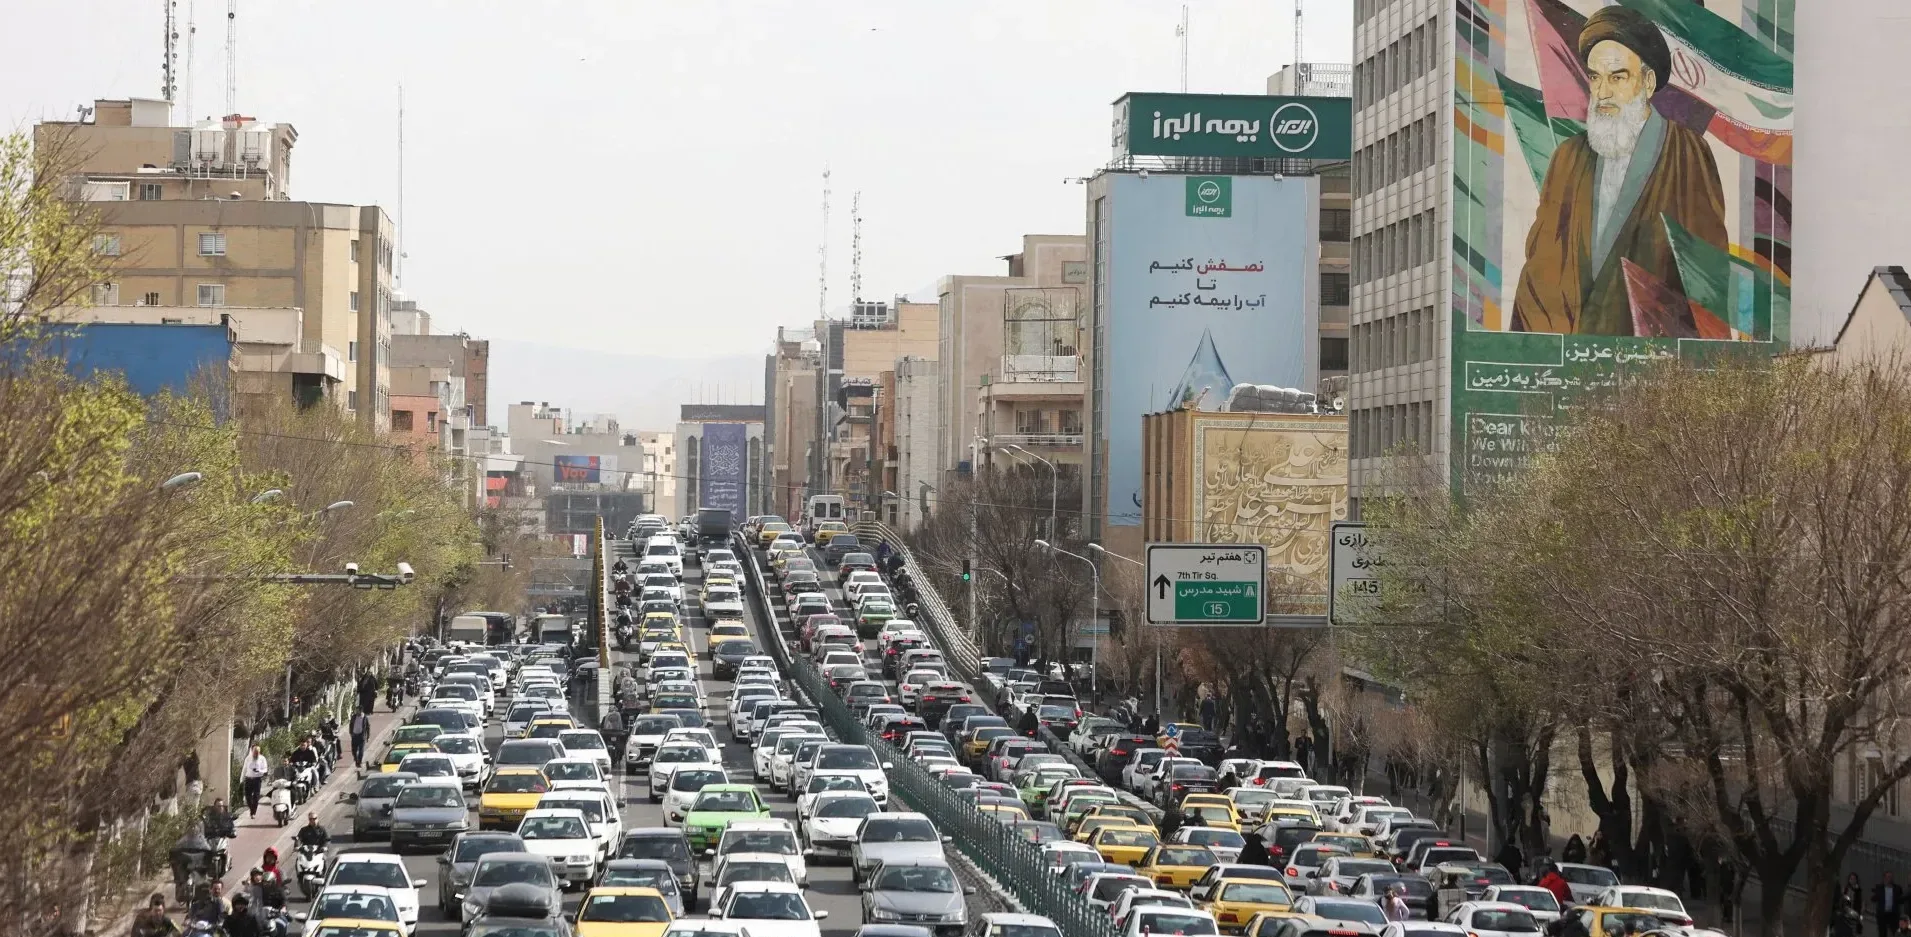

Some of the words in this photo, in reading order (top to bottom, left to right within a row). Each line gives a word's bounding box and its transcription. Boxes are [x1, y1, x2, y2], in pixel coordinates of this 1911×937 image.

[1153, 111, 1201, 141] البرز
[1205, 119, 1260, 143] بیمه
[1192, 204, 1208, 215] البرز
[1208, 206, 1225, 216] بیمه
[1149, 257, 1194, 274] کنیم
[1196, 257, 1264, 274] نصفش
[1196, 278, 1217, 291] تا
[1149, 292, 1191, 309] کنیم
[1193, 293, 1232, 311] بیمه
[1233, 294, 1243, 311] را
[1245, 294, 1267, 310] آب
[1565, 342, 1613, 363] عزیز،
[1471, 368, 1511, 388] زمین
[1512, 372, 1530, 390] به
[1471, 417, 1515, 435] Dear
[1471, 437, 1496, 451] We
[1200, 553, 1216, 564] تیر
[1217, 553, 1242, 565] هفتم
[1177, 571, 1191, 580] 7th
[1192, 571, 1202, 580] Tir
[1204, 571, 1219, 581] Sq.
[1179, 587, 1213, 598] مدرس
[1215, 584, 1242, 597] شهید
[1209, 603, 1223, 615] 15
